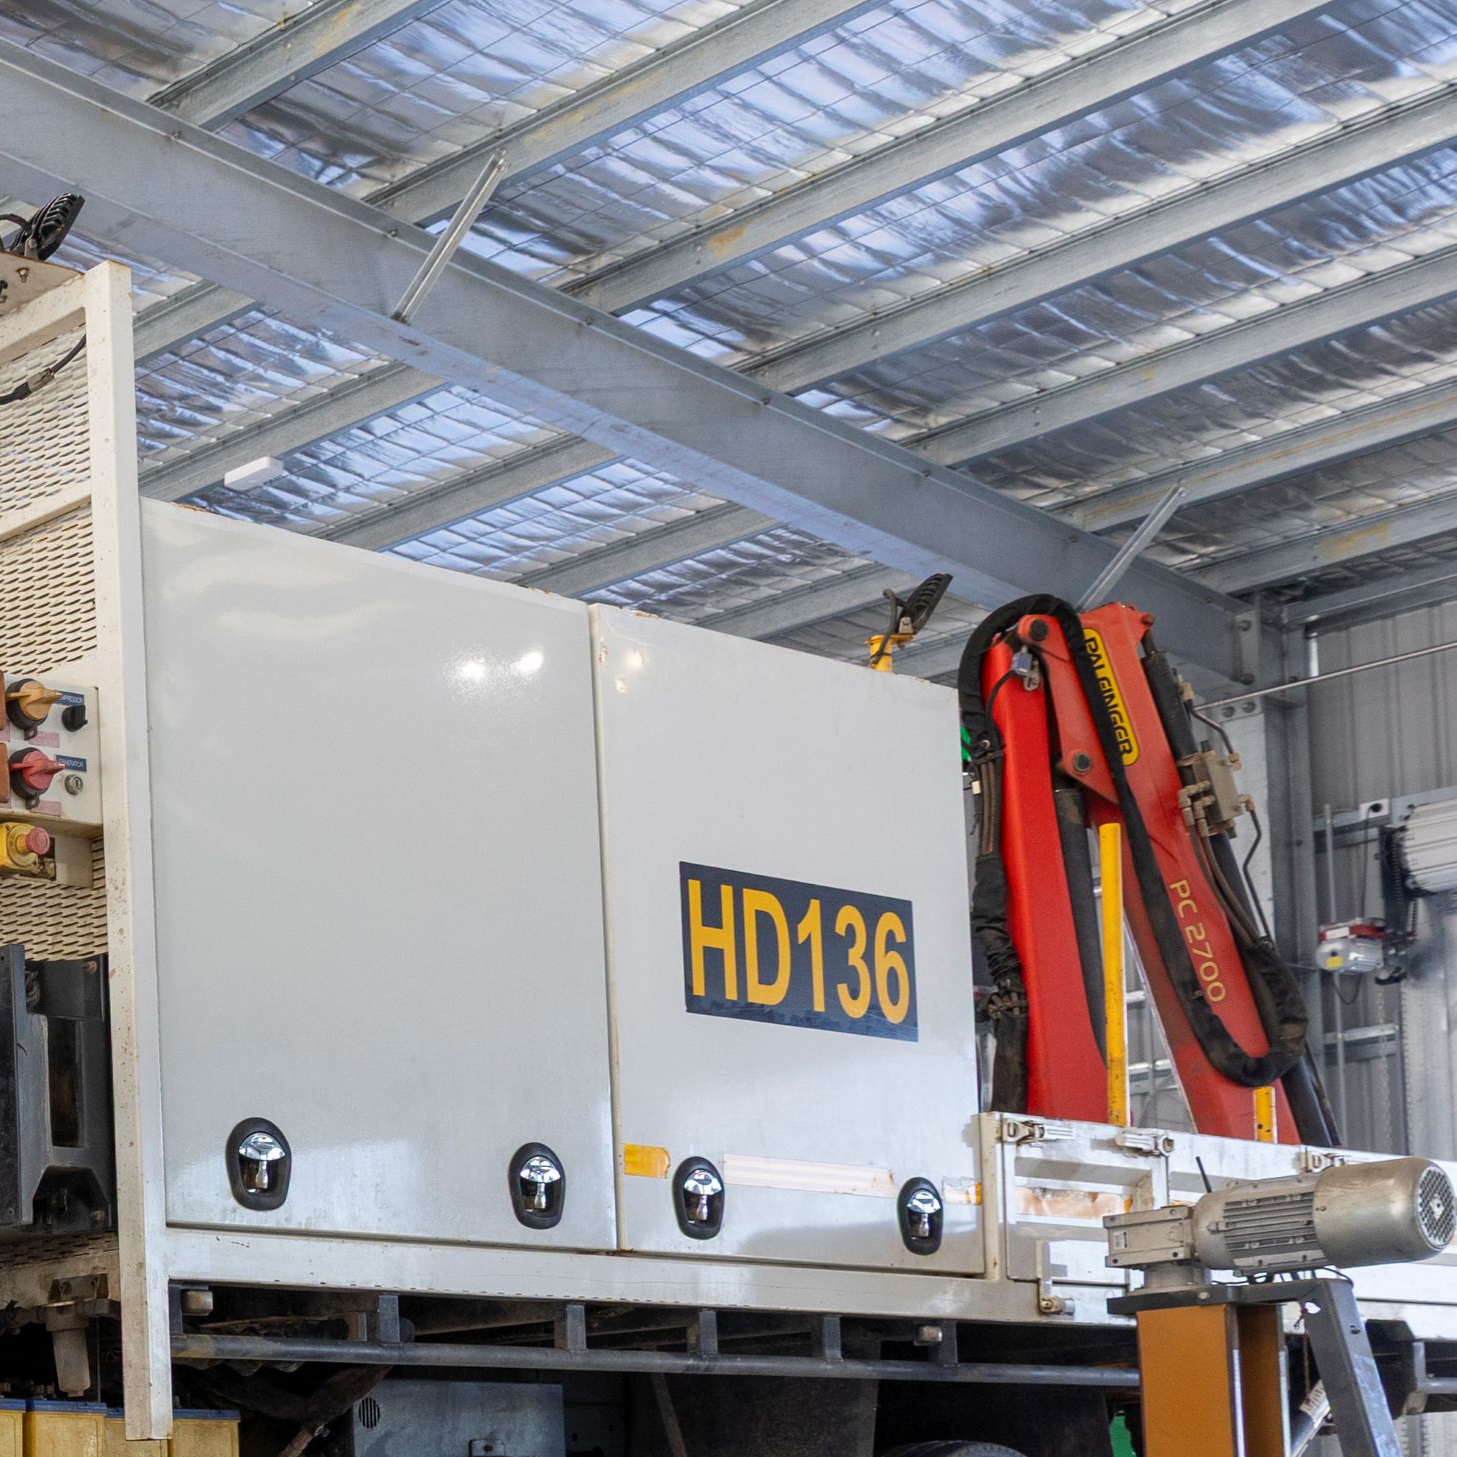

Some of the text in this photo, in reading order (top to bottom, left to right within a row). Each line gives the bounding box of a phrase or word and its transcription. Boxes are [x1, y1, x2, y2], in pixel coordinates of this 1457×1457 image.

[686, 879, 909, 1024] HD136
[1170, 879, 1226, 1003] PC 2700
